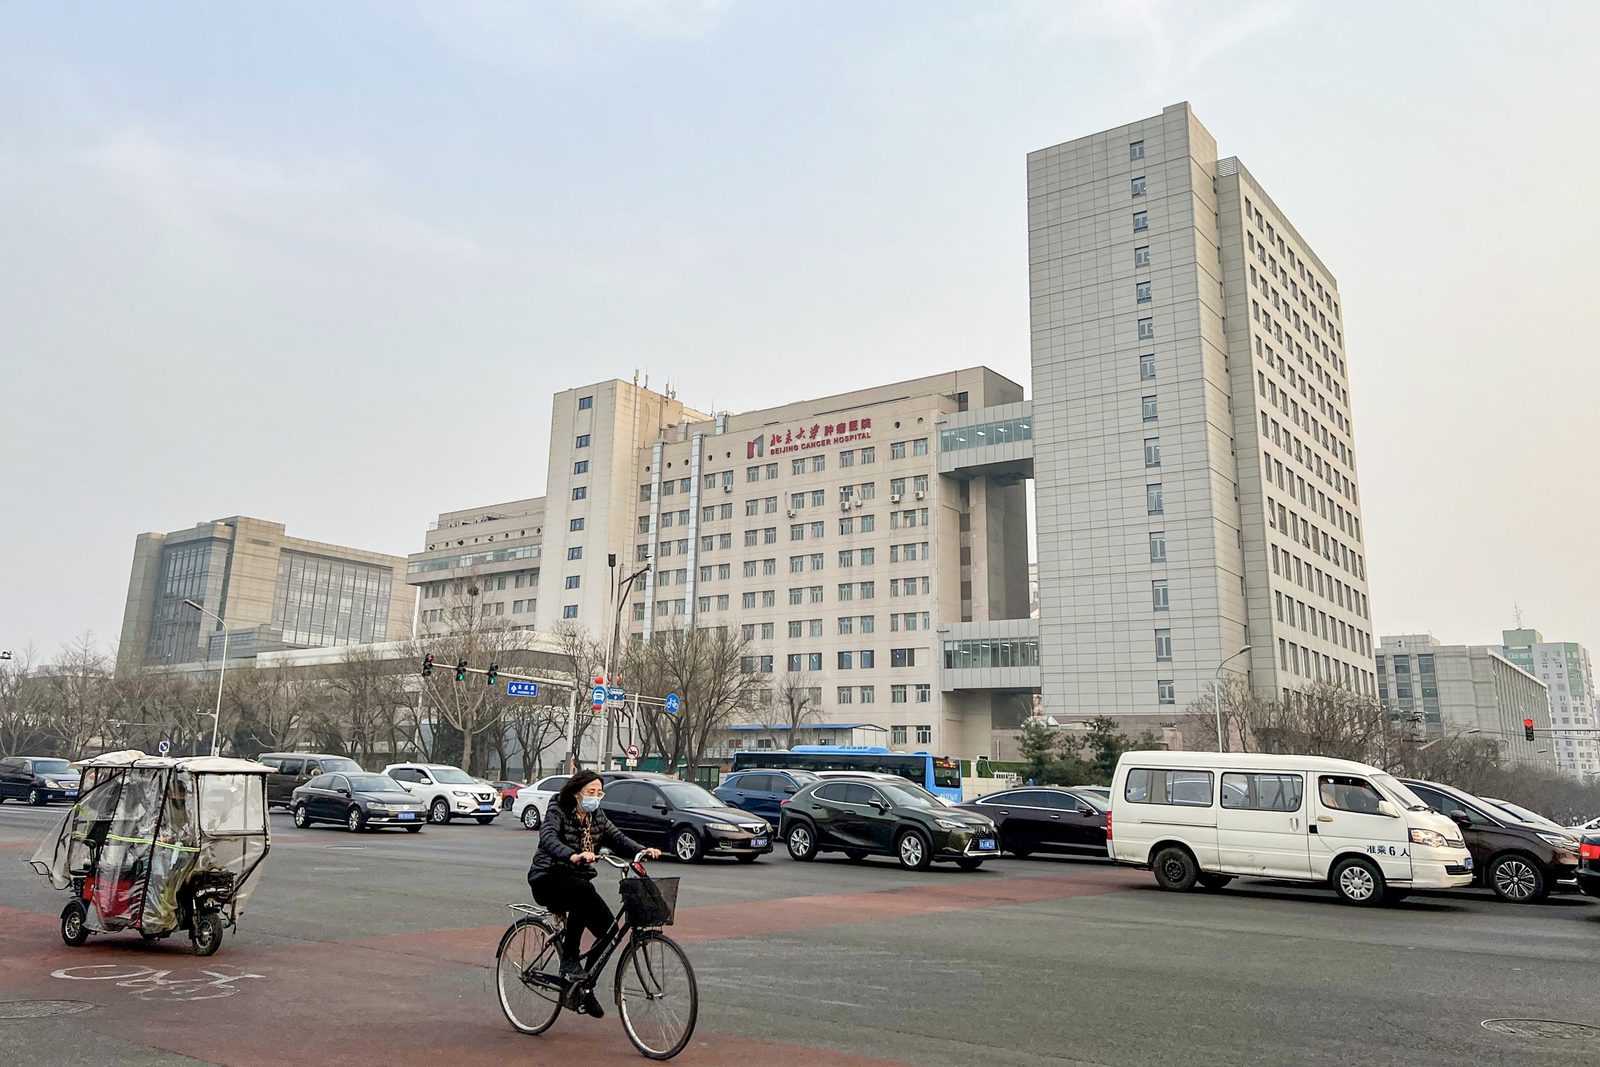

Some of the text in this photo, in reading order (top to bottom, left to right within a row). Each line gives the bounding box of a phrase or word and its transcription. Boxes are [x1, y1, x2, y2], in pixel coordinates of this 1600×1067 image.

[770, 418, 871, 446] 北京大学肿瘤医院
[770, 432, 871, 455] BEIJING CANCER HOSPITAL
